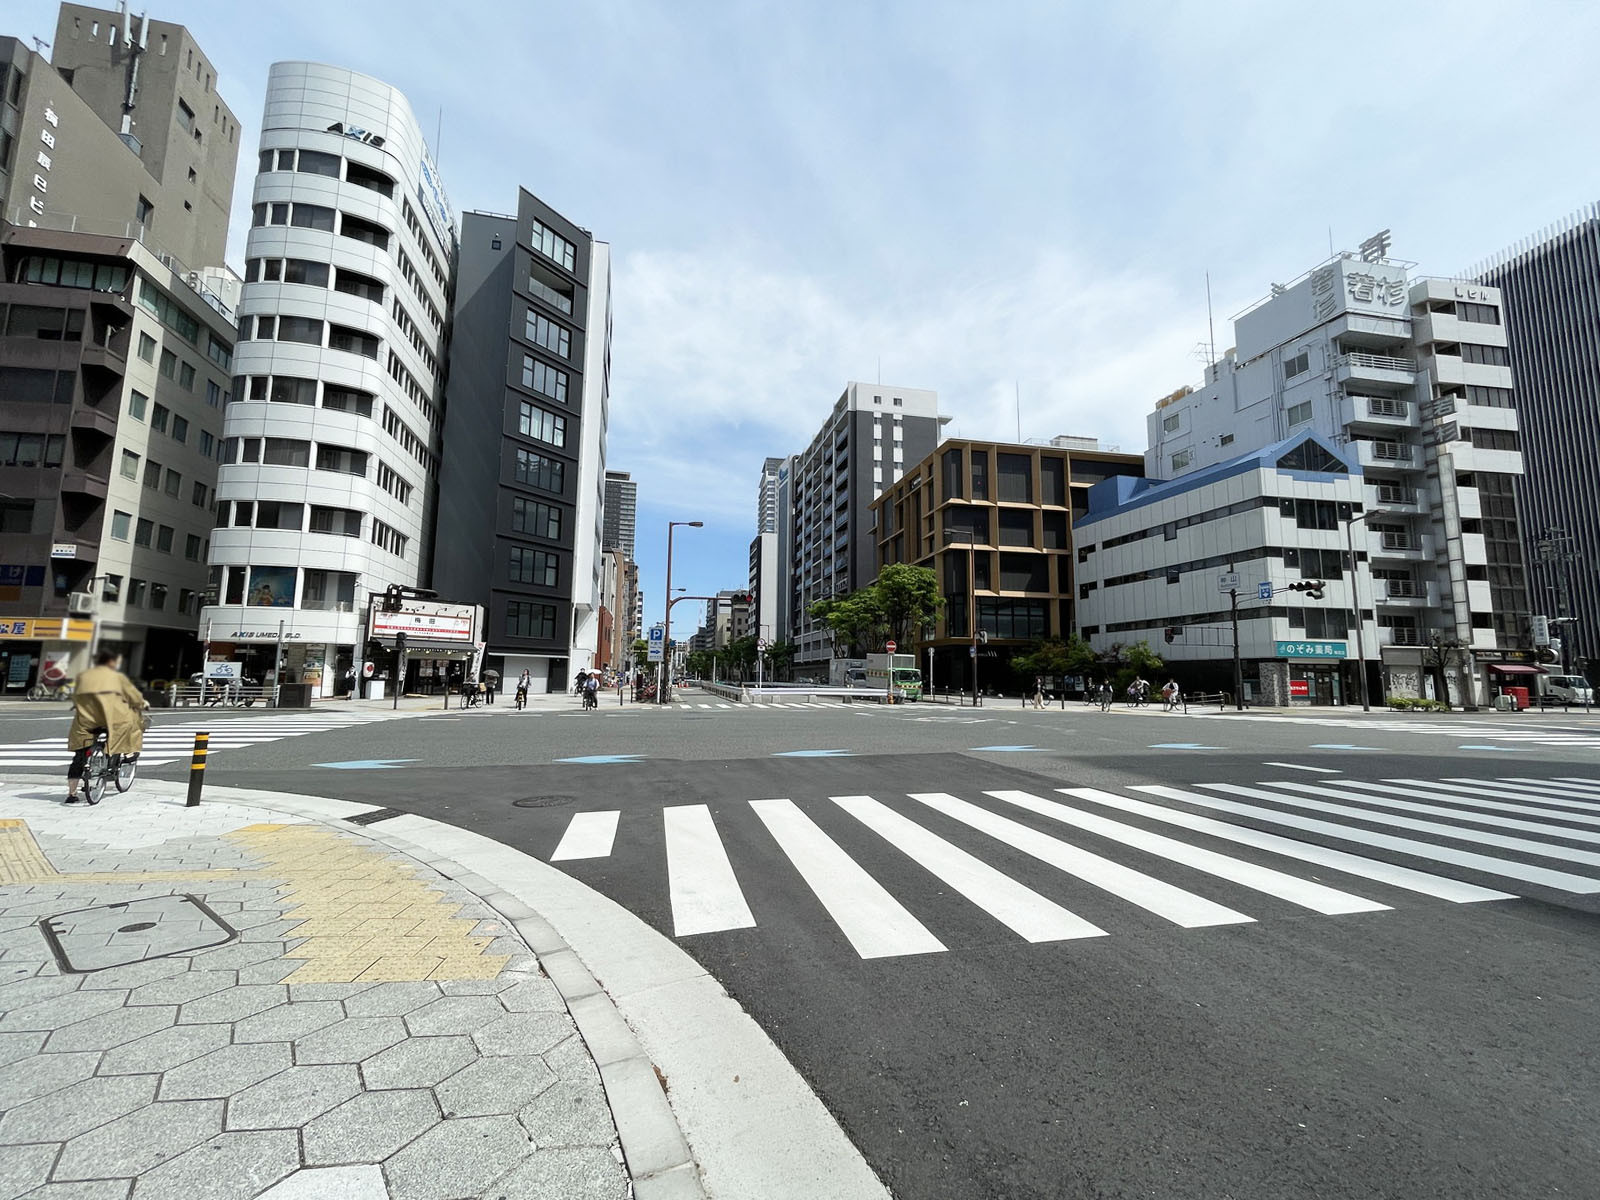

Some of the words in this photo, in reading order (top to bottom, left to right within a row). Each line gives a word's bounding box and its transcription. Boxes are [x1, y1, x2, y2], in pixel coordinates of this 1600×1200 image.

[327, 122, 386, 147] AXIS
[1348, 272, 1405, 306] 若杉
[653, 629, 661, 640] P
[1286, 644, 1333, 655] のぞみ薬局
